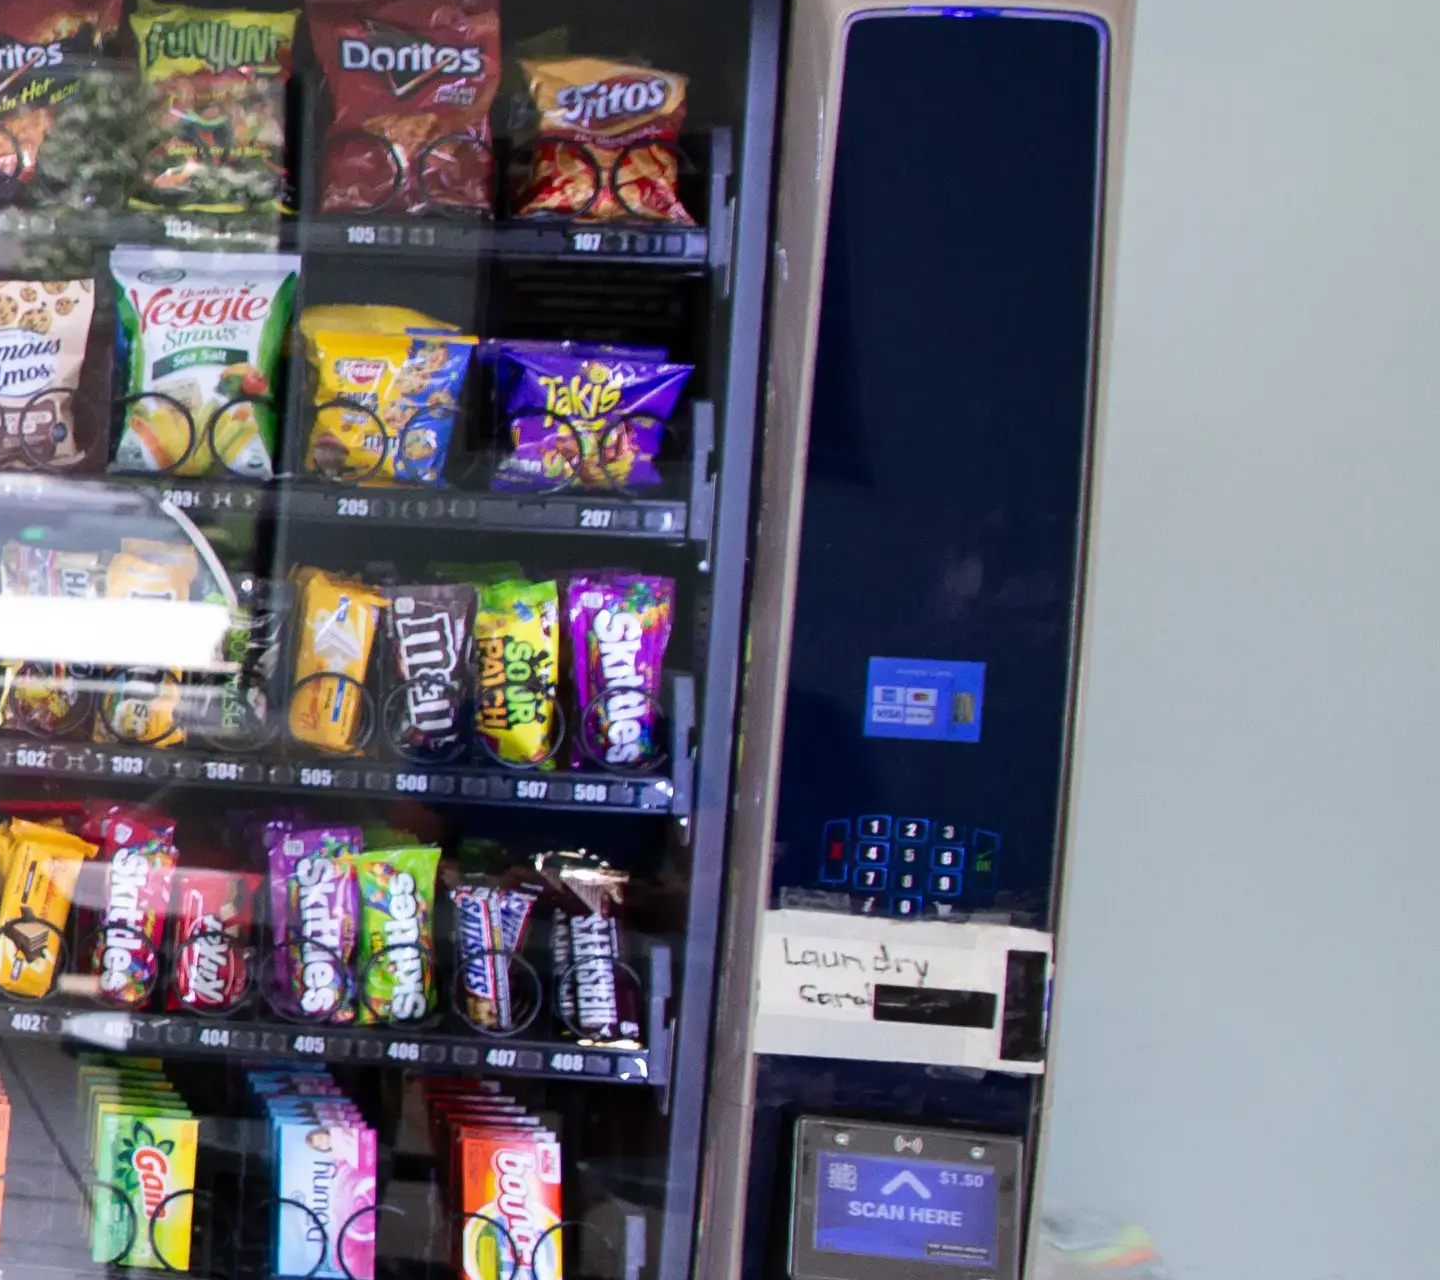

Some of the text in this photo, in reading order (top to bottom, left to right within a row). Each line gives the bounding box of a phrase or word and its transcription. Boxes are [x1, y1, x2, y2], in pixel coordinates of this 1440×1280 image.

[340, 38, 482, 74] Doritos
[557, 79, 666, 124] Fritos
[347, 226, 375, 243] 105
[573, 233, 600, 250] 107
[130, 287, 268, 334] Veggie
[539, 375, 622, 427] Takis
[337, 498, 368, 516] 205
[581, 511, 610, 528] 207
[478, 637, 507, 730] PATCH
[506, 640, 536, 727] SOUR
[593, 609, 651, 765] Skittles
[16, 749, 46, 767] 502
[112, 756, 143, 774] 503
[300, 769, 331, 786] 505
[396, 774, 428, 792] 506
[517, 781, 547, 799] 507
[575, 784, 606, 802] 508
[870, 819, 879, 834] 1
[905, 823, 917, 837] 2
[942, 825, 954, 839] 3
[866, 846, 878, 860] 4
[904, 848, 915, 862] 5
[940, 851, 952, 865] 6
[866, 871, 875, 886] 7
[939, 876, 950, 891] 9
[900, 899, 911, 914] 0
[100, 847, 149, 991] Skittles
[295, 857, 342, 1013] Skittles
[383, 872, 427, 1020] Skittles
[782, 936, 929, 986] Laundry
[799, 982, 874, 1008] Card
[11, 1013, 41, 1031] 402
[199, 1028, 229, 1046] 404
[293, 1036, 325, 1054] 405
[388, 1042, 419, 1060] 406
[486, 1049, 516, 1067] 407
[551, 1053, 583, 1071] 408
[133, 1147, 168, 1219] Gain
[938, 1171, 984, 1188] $1.50
[305, 1159, 337, 1243] Downy
[848, 1201, 963, 1227] SCAN HERE
